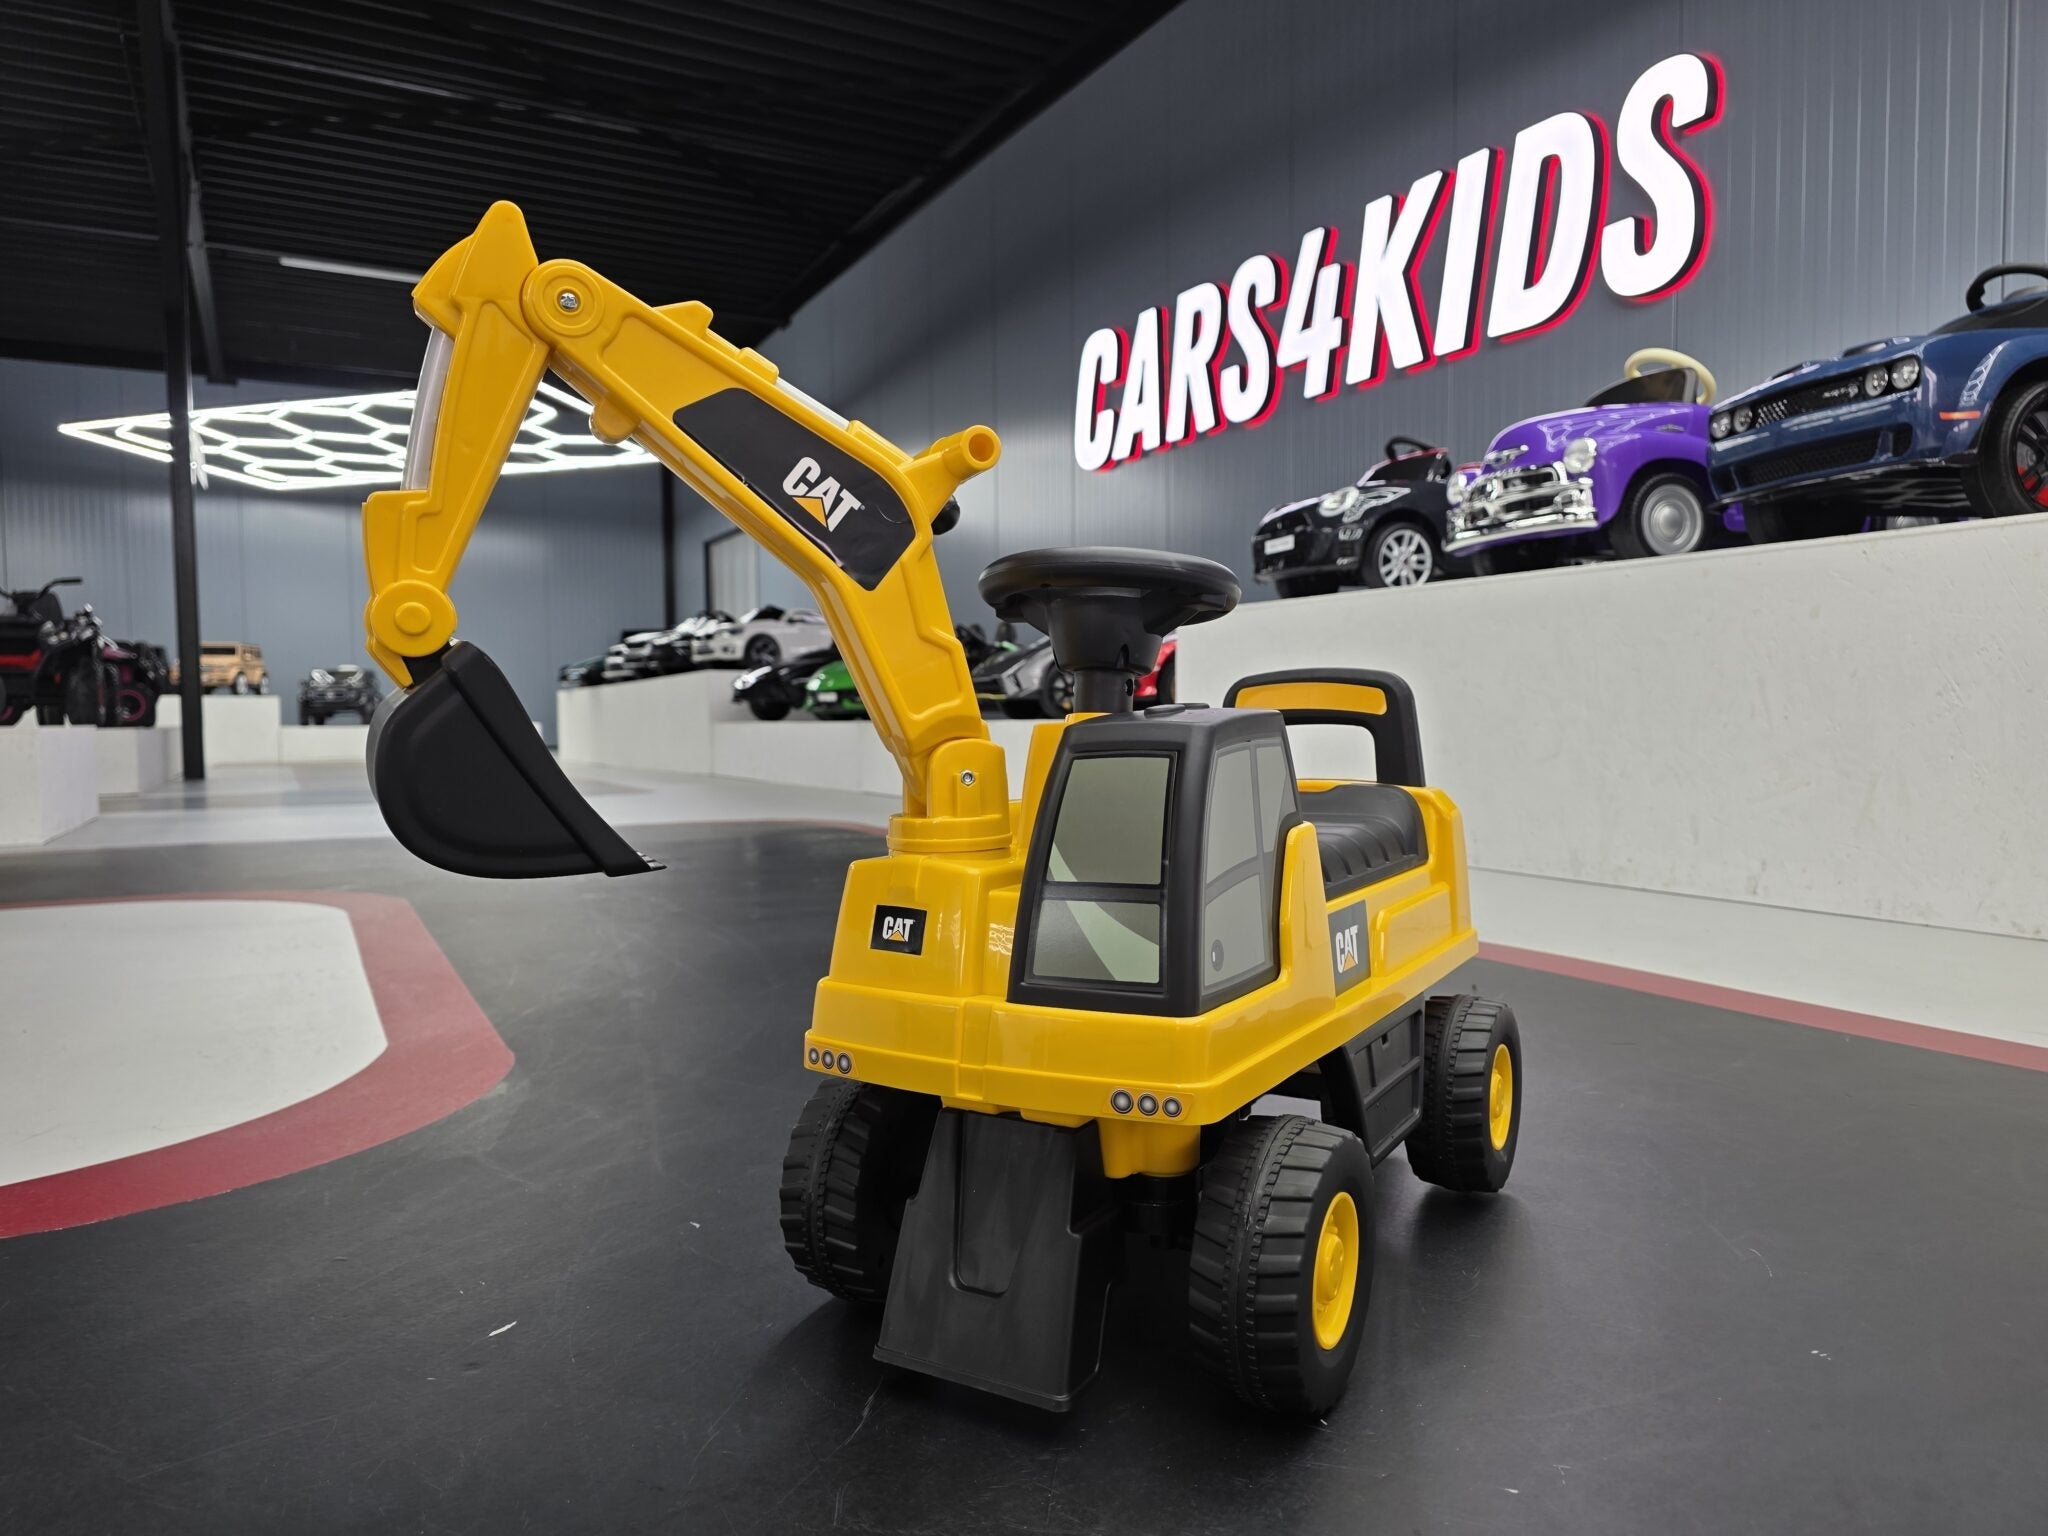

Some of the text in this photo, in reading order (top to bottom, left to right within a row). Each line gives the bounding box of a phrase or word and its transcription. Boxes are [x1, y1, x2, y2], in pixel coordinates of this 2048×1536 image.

[1074, 53, 1716, 472] CARS4KIDS
[782, 456, 865, 533] CAT
[882, 916, 915, 942] CAT
[1335, 925, 1358, 973] CAT
